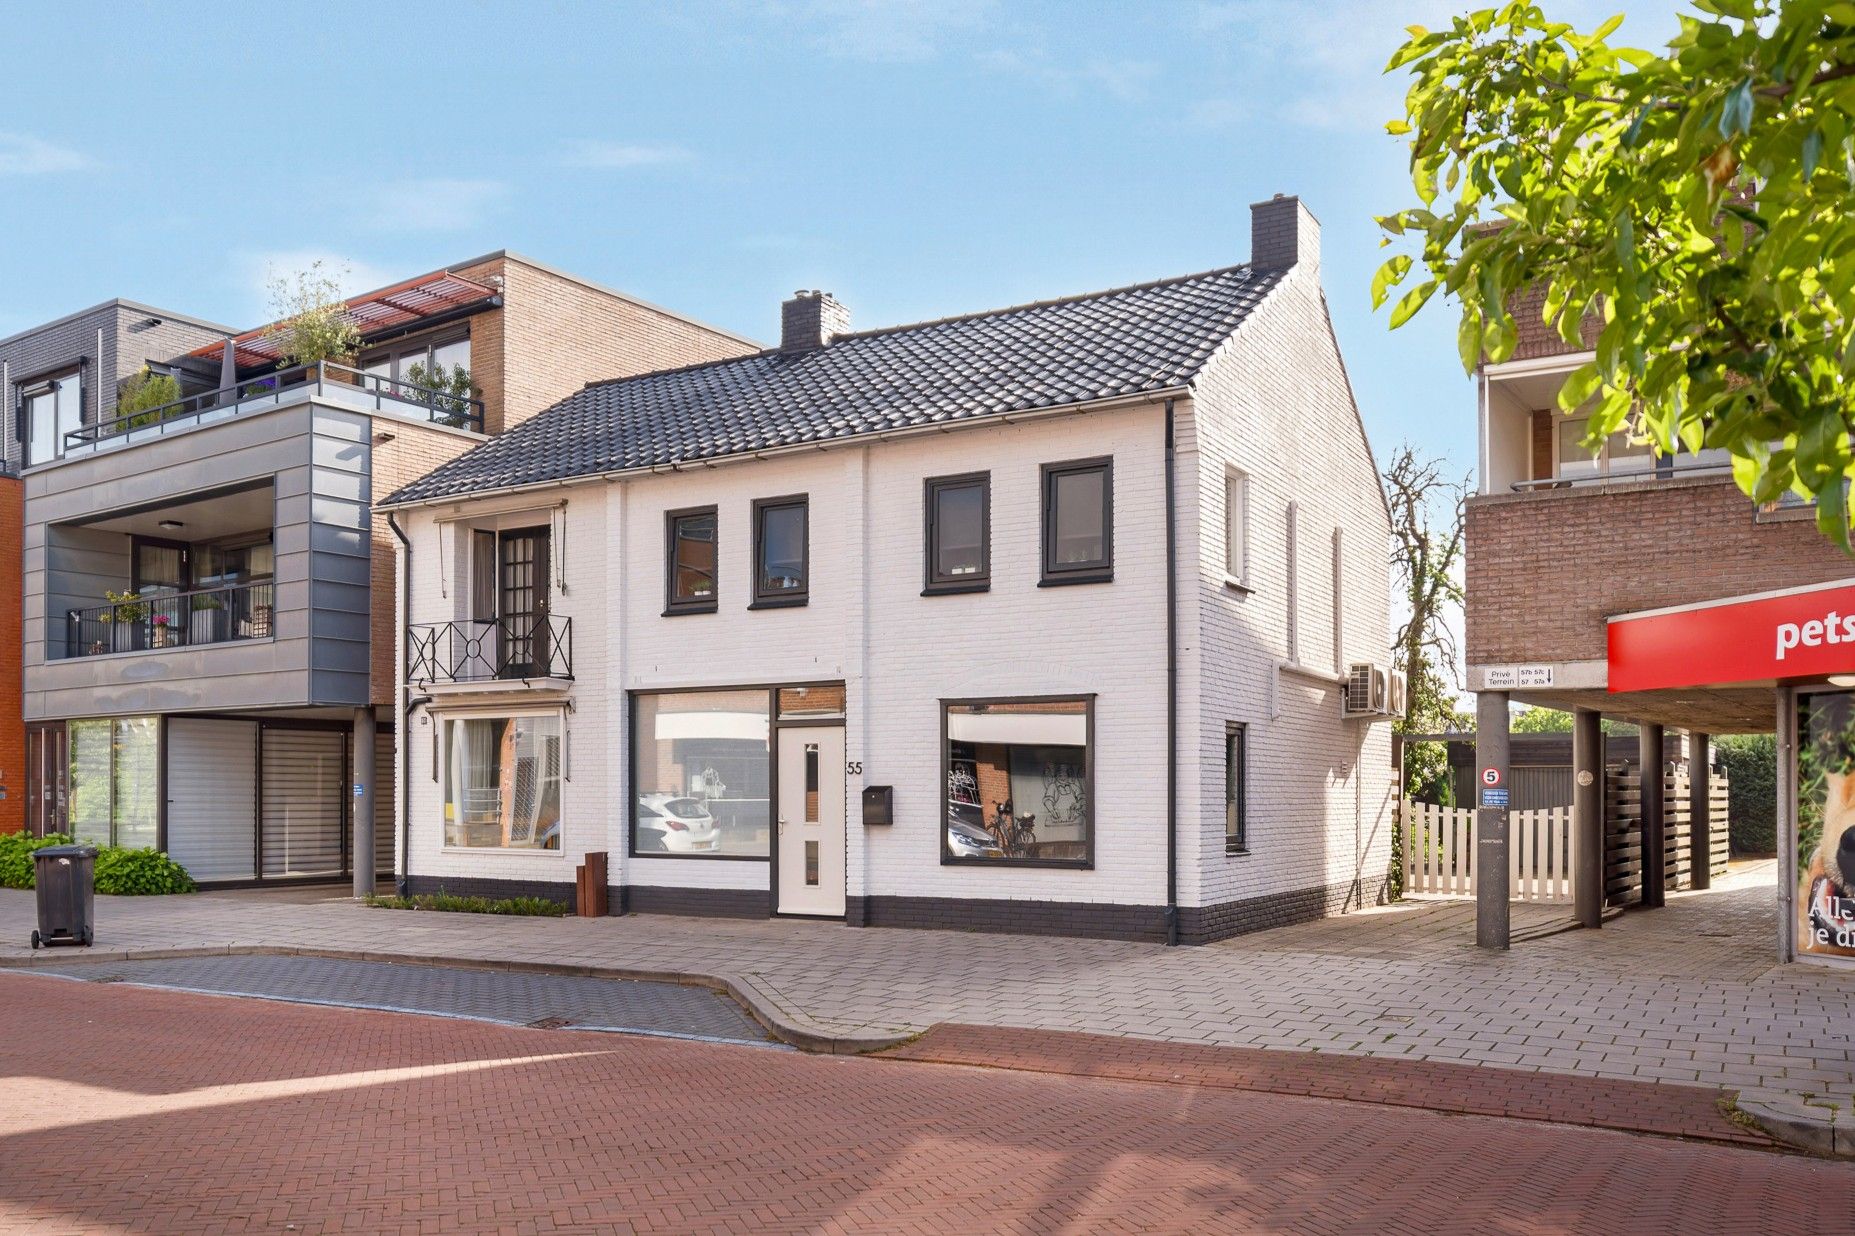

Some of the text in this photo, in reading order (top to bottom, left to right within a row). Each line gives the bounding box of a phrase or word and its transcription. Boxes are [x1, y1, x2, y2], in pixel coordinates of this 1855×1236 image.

[1775, 610, 1855, 661] pets
[847, 762, 862, 775] 55
[1487, 771, 1496, 782] 5
[1806, 920, 1829, 949] je
